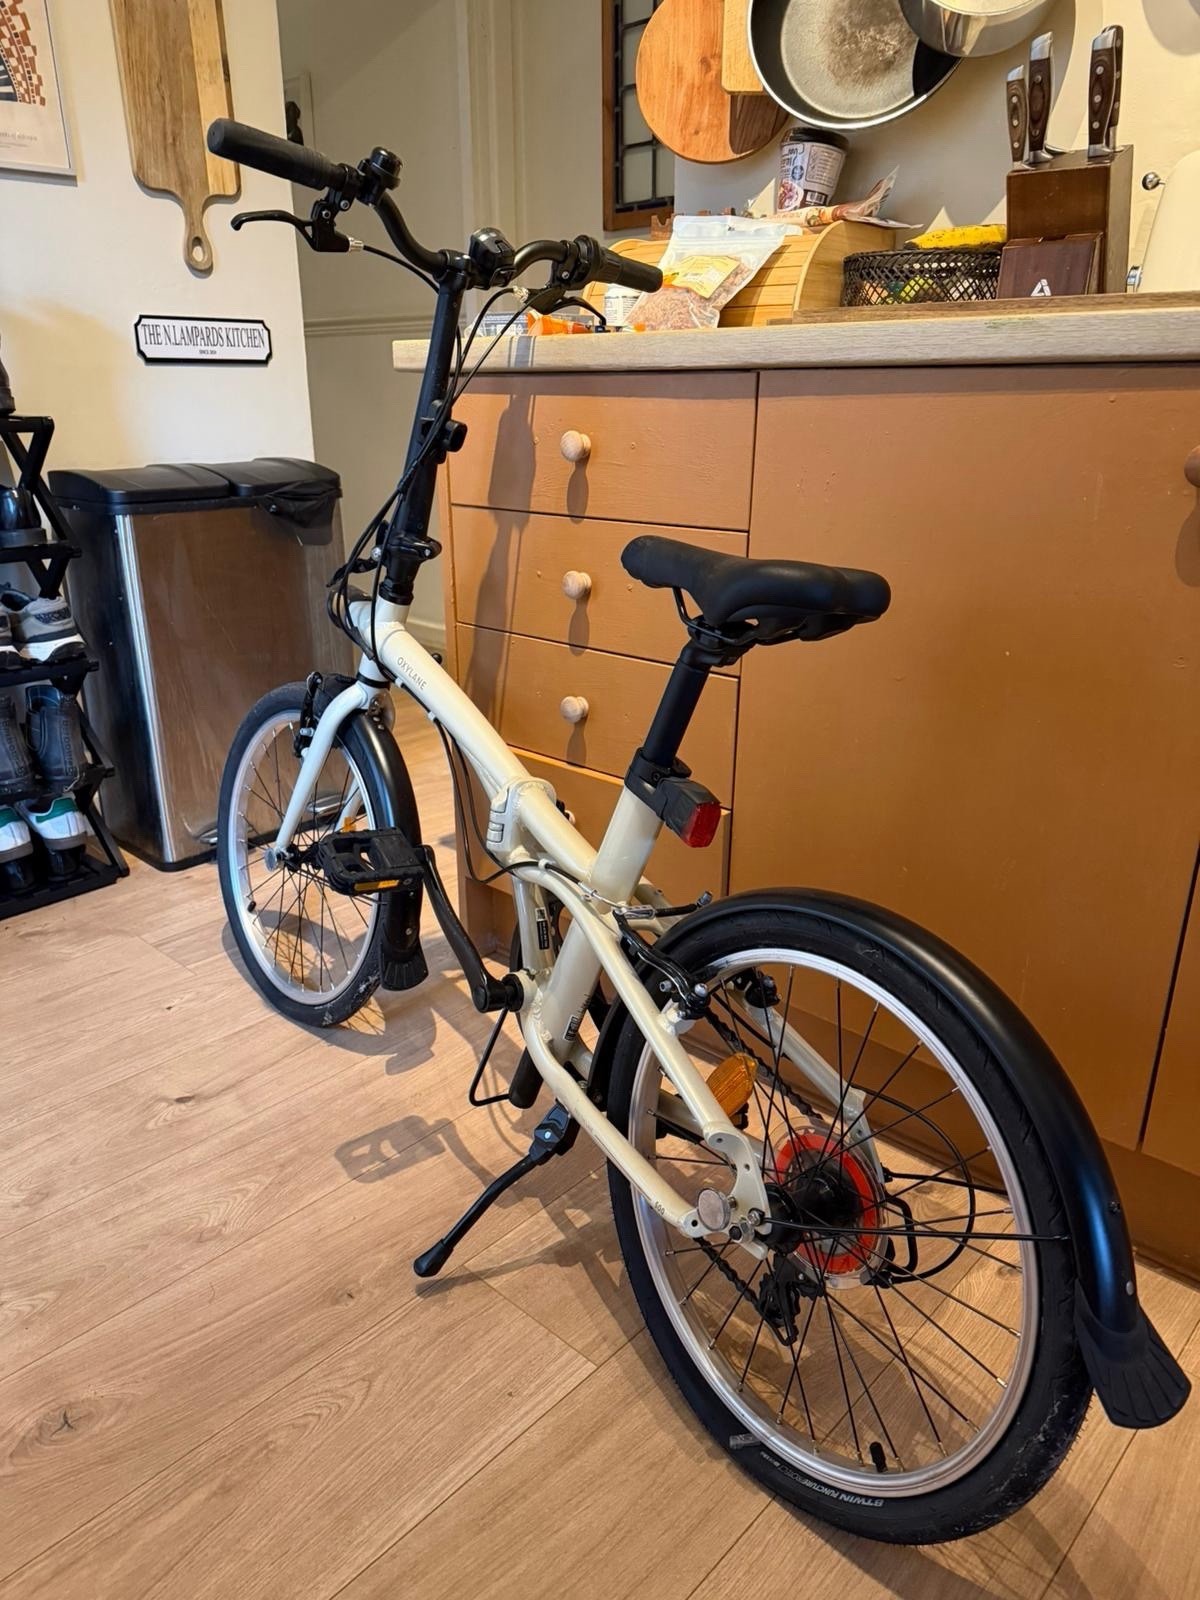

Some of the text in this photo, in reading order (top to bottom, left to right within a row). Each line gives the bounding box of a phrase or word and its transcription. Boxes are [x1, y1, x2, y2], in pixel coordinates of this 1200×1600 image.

[141, 324, 162, 345] THE
[225, 328, 265, 348] KITCHEN
[397, 656, 427, 690] OXYLANE
